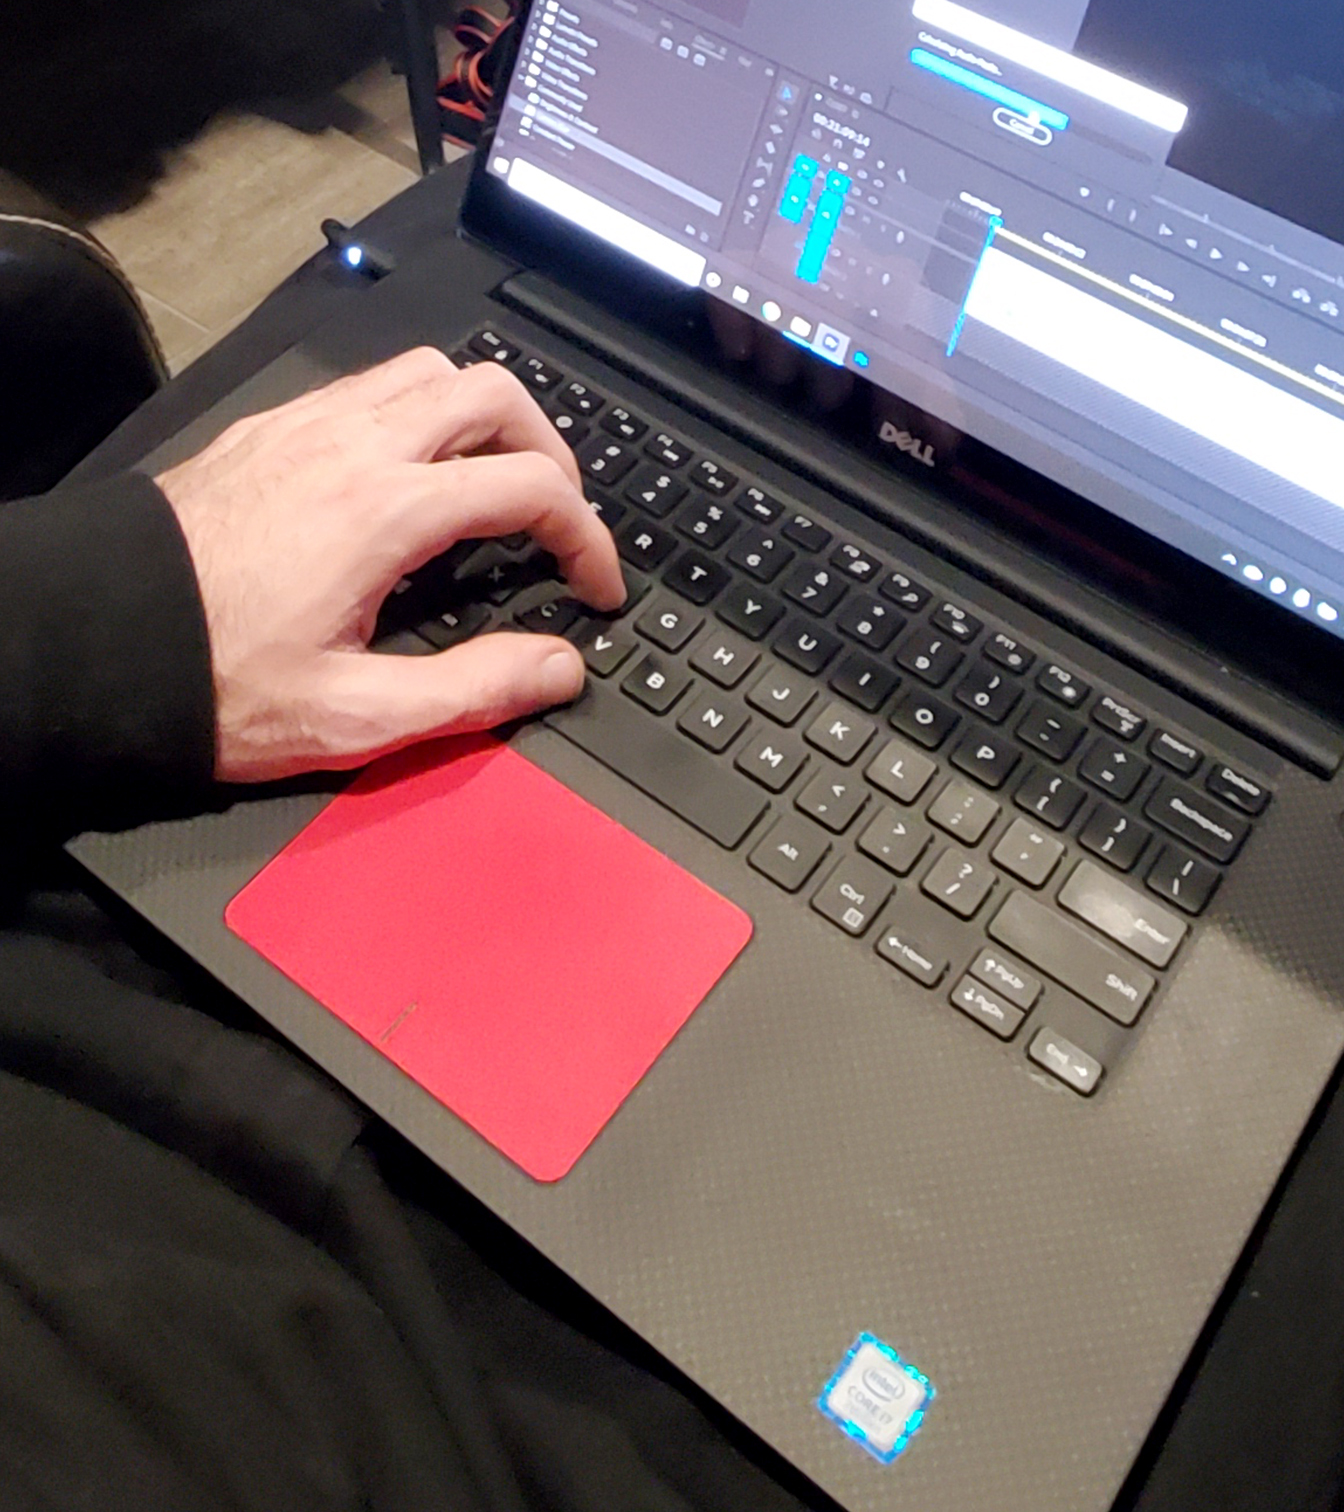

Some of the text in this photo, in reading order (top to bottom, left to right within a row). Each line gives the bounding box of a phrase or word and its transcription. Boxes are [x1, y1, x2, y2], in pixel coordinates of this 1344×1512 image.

[878, 420, 936, 468] DELL
[693, 521, 708, 534] 5
[634, 533, 653, 550] R
[746, 553, 762, 567] 6
[690, 565, 708, 581] T
[801, 586, 818, 599] 7
[744, 598, 762, 615] Y
[661, 613, 679, 629] G
[595, 635, 613, 651] V
[798, 634, 818, 651] U
[713, 646, 735, 666] H
[646, 672, 666, 690] B
[772, 688, 791, 701] J
[703, 708, 724, 728] N
[914, 708, 934, 725] O
[829, 721, 851, 741] K
[759, 746, 784, 768] M
[976, 744, 996, 760] P
[890, 760, 904, 779] L
[847, 1385, 881, 1416] CORE
